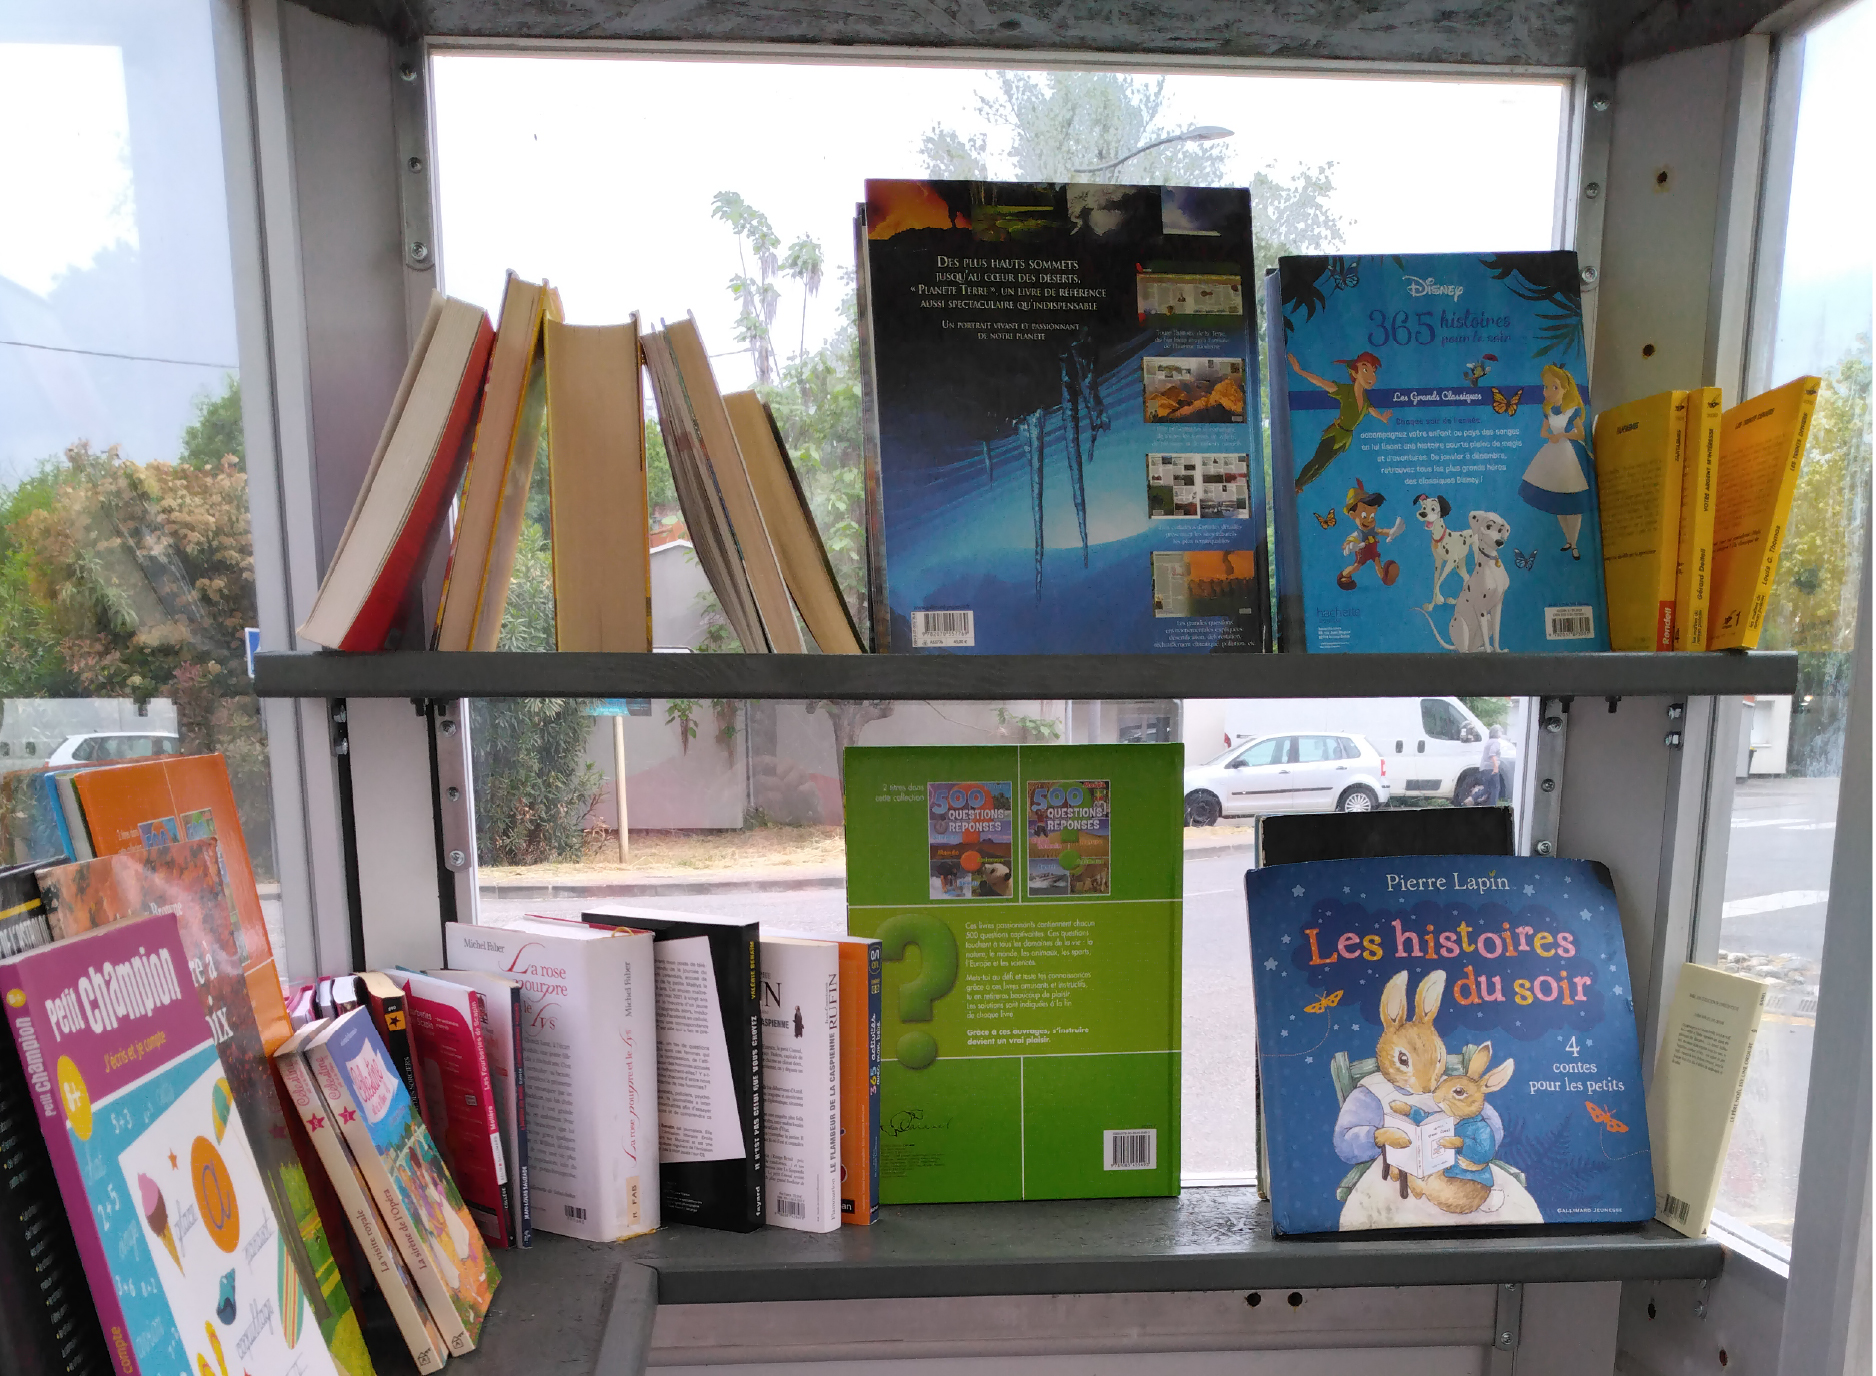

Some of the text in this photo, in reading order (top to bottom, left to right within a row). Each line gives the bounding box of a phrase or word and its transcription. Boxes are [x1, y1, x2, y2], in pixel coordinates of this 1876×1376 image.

[964, 259, 987, 268] PLUS
[992, 259, 1024, 269] HAUTS
[1029, 260, 1079, 270] SOMMETS
[936, 270, 981, 282] JUSQU'AU
[1019, 274, 1035, 283] DES
[920, 300, 1097, 310] AUSSI SPECTACULAIRE QU'INDISPENSABLE
[1368, 309, 1511, 347] 365 histoires
[1393, 391, 1481, 405] Les Grands Classiques
[1762, 525, 1781, 585] Louis Thomas
[893, 793, 924, 802] collection
[932, 789, 985, 814] 500
[1032, 787, 1083, 811] 500
[949, 810, 1004, 819] QUESTIONS
[1047, 808, 1103, 817] QUESTIONS
[1386, 871, 1510, 896] Pierre Lapin
[464, 938, 505, 953] Michel Faber
[980, 931, 1008, 939] questions
[1305, 919, 1576, 966] Les histoires
[498, 942, 566, 979] La rose
[624, 962, 632, 985] Faber
[45, 947, 181, 1042] Petit Champion
[1010, 991, 1040, 1000] beaucoup
[1454, 966, 1592, 1005] du soir
[524, 1000, 532, 1014] le
[829, 973, 837, 1030] RUFIN
[472, 1001, 480, 1026] Scapin
[104, 1031, 166, 1073] J'écris et je compte
[1026, 1037, 1051, 1045] plaisir.
[1566, 1035, 1580, 1056] 4
[477, 1037, 488, 1078] Fourberies
[626, 1051, 633, 1059] le
[16, 1017, 56, 1117] Petit Champion
[1553, 1060, 1597, 1074] contes
[627, 1071, 640, 1121] pourpre
[830, 1085, 835, 1096] LA
[1530, 1077, 1625, 1094] pour les petits
[830, 1099, 836, 1110] DE
[488, 1105, 496, 1130] Molière
[830, 1162, 836, 1173] LE
[357, 1209, 390, 1272] La visite royale
[384, 1188, 427, 1270] La sirène de l'Opéra
[111, 1326, 133, 1374] compte
